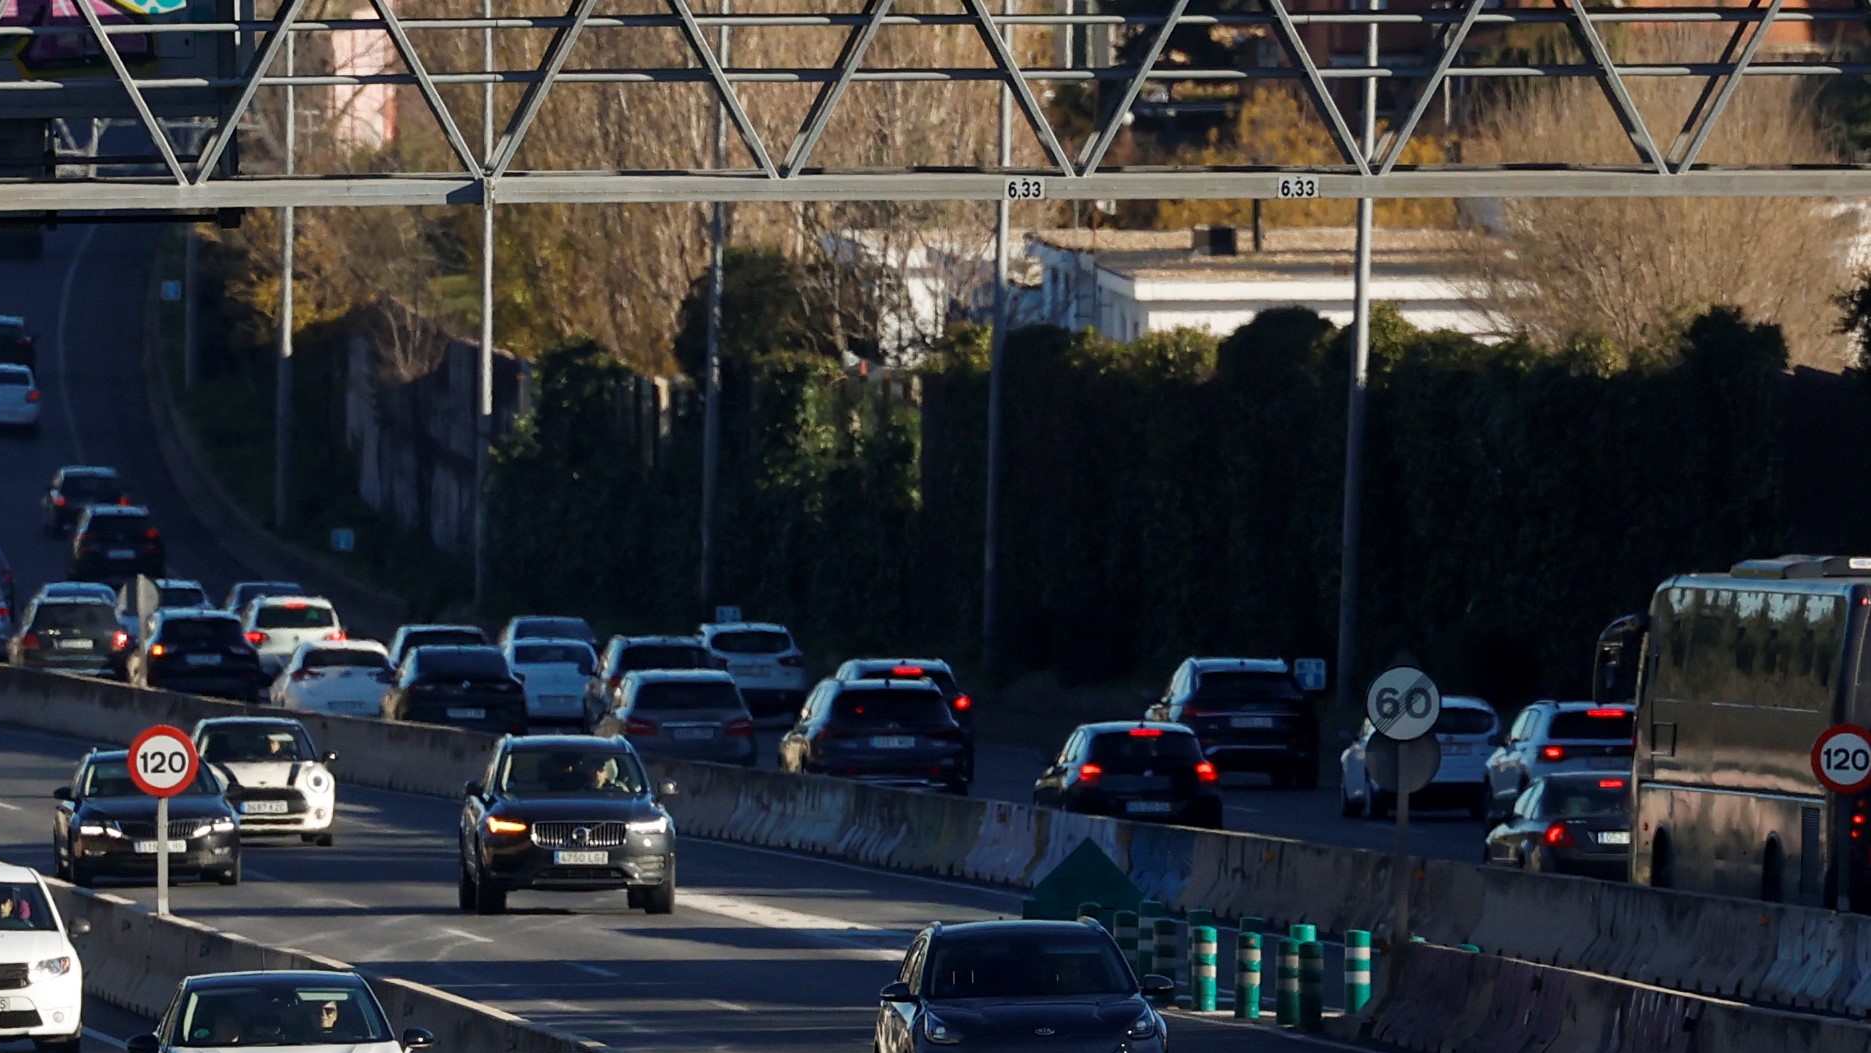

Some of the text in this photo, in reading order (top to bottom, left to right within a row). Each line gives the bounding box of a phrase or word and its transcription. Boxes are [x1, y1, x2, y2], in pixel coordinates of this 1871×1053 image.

[1008, 181, 1041, 200] 6,33
[1281, 180, 1315, 199] 6,33
[1375, 687, 1432, 720] 60
[140, 751, 186, 774] 120
[1823, 748, 1870, 771] 120
